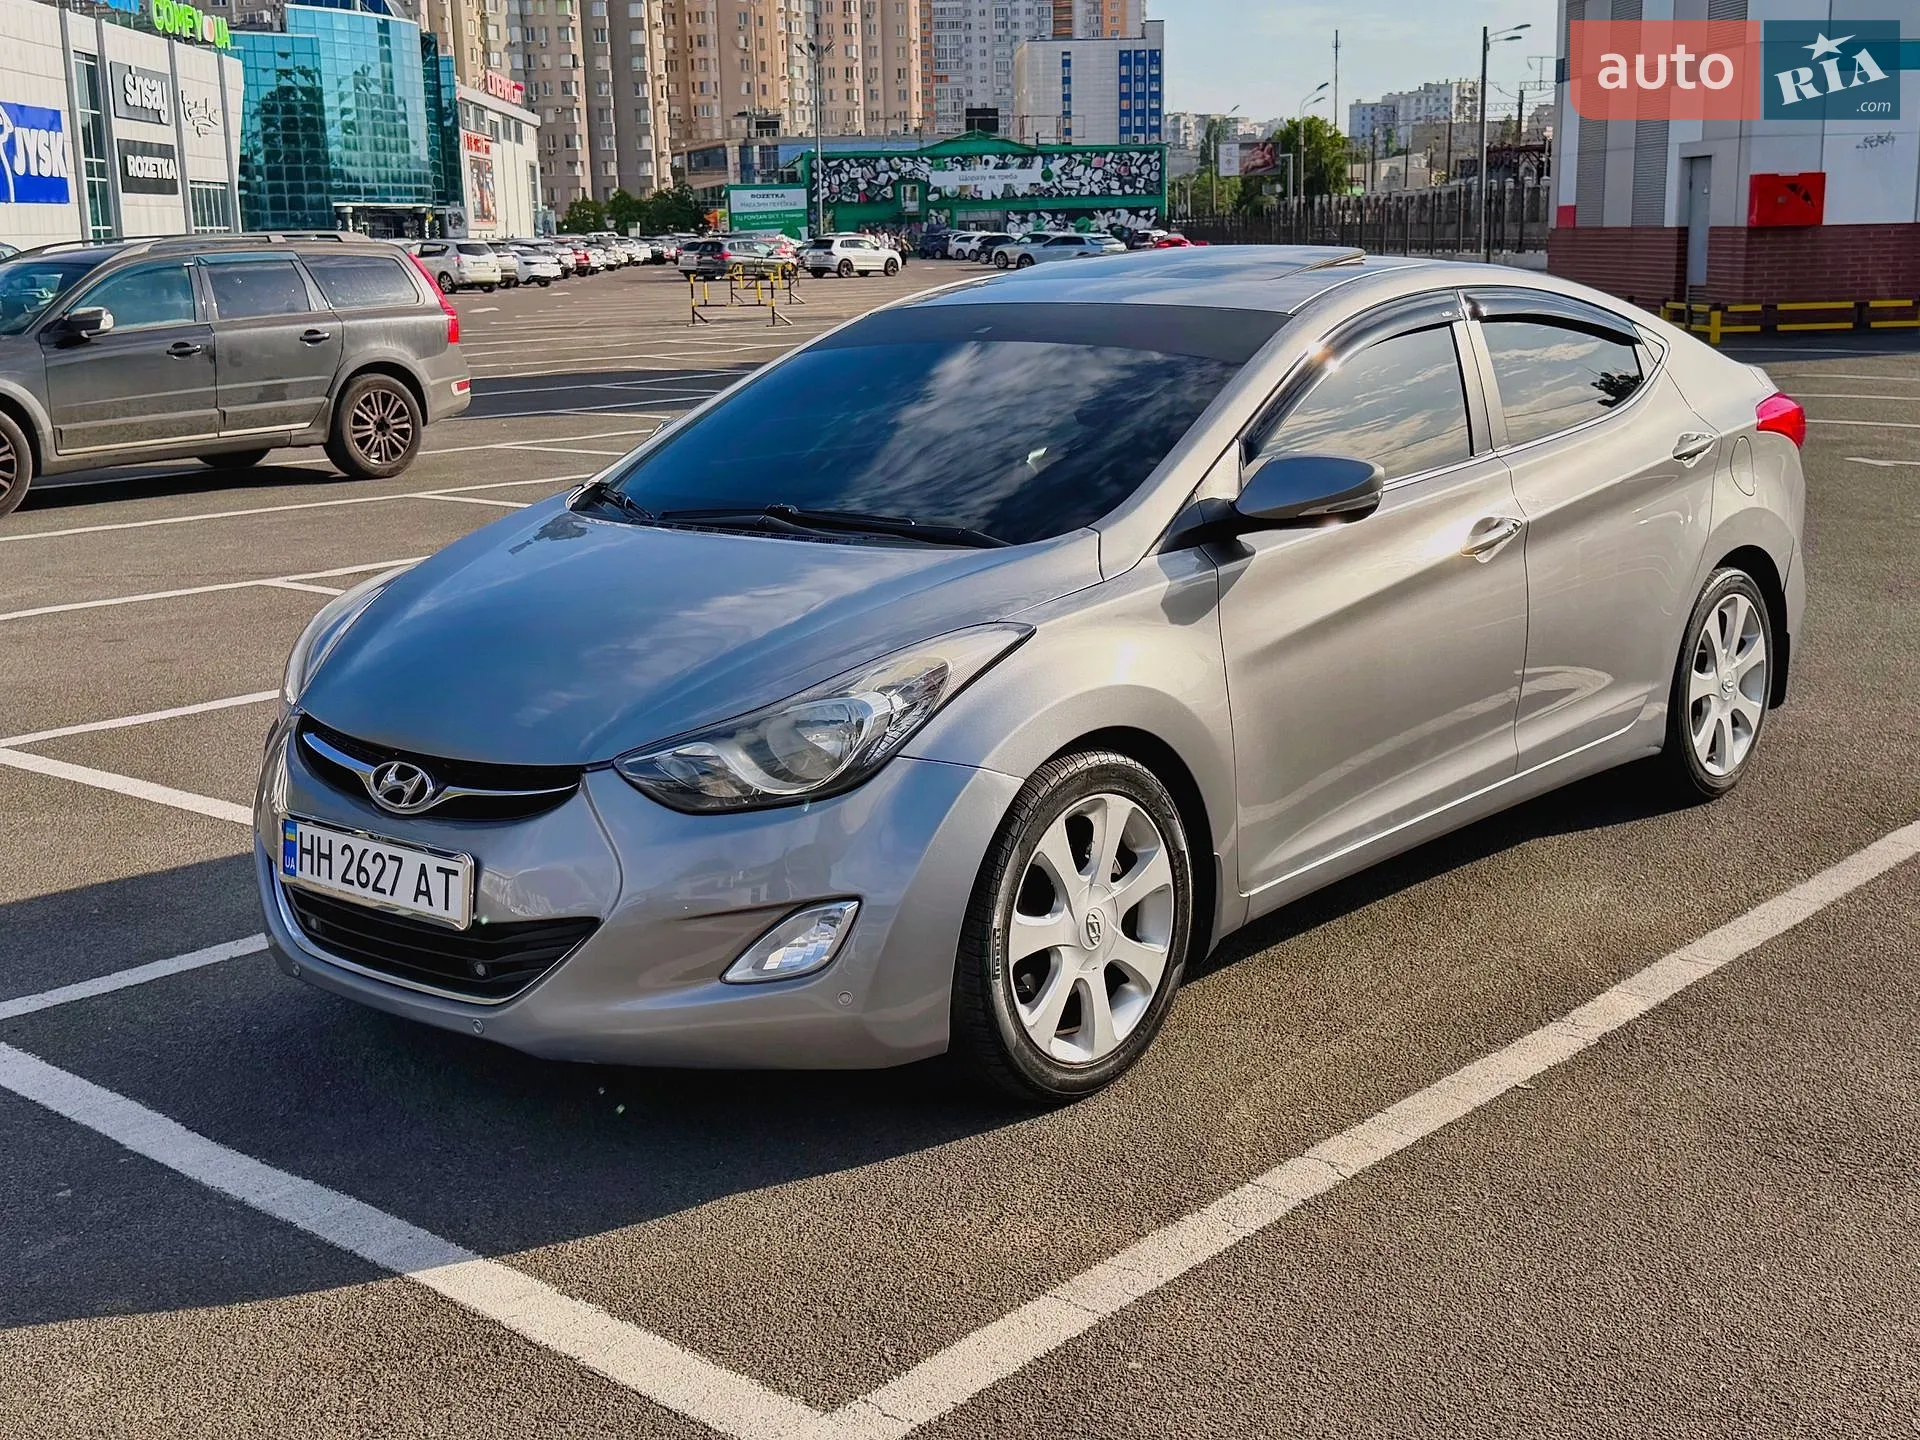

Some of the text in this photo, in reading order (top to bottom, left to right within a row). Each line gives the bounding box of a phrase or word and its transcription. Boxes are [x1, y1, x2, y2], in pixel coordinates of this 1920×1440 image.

[14, 127, 68, 178] JYSK
[126, 155, 177, 179] ROZETKA
[284, 856, 296, 870] UA
[300, 831, 459, 911] HH 2627 AT
